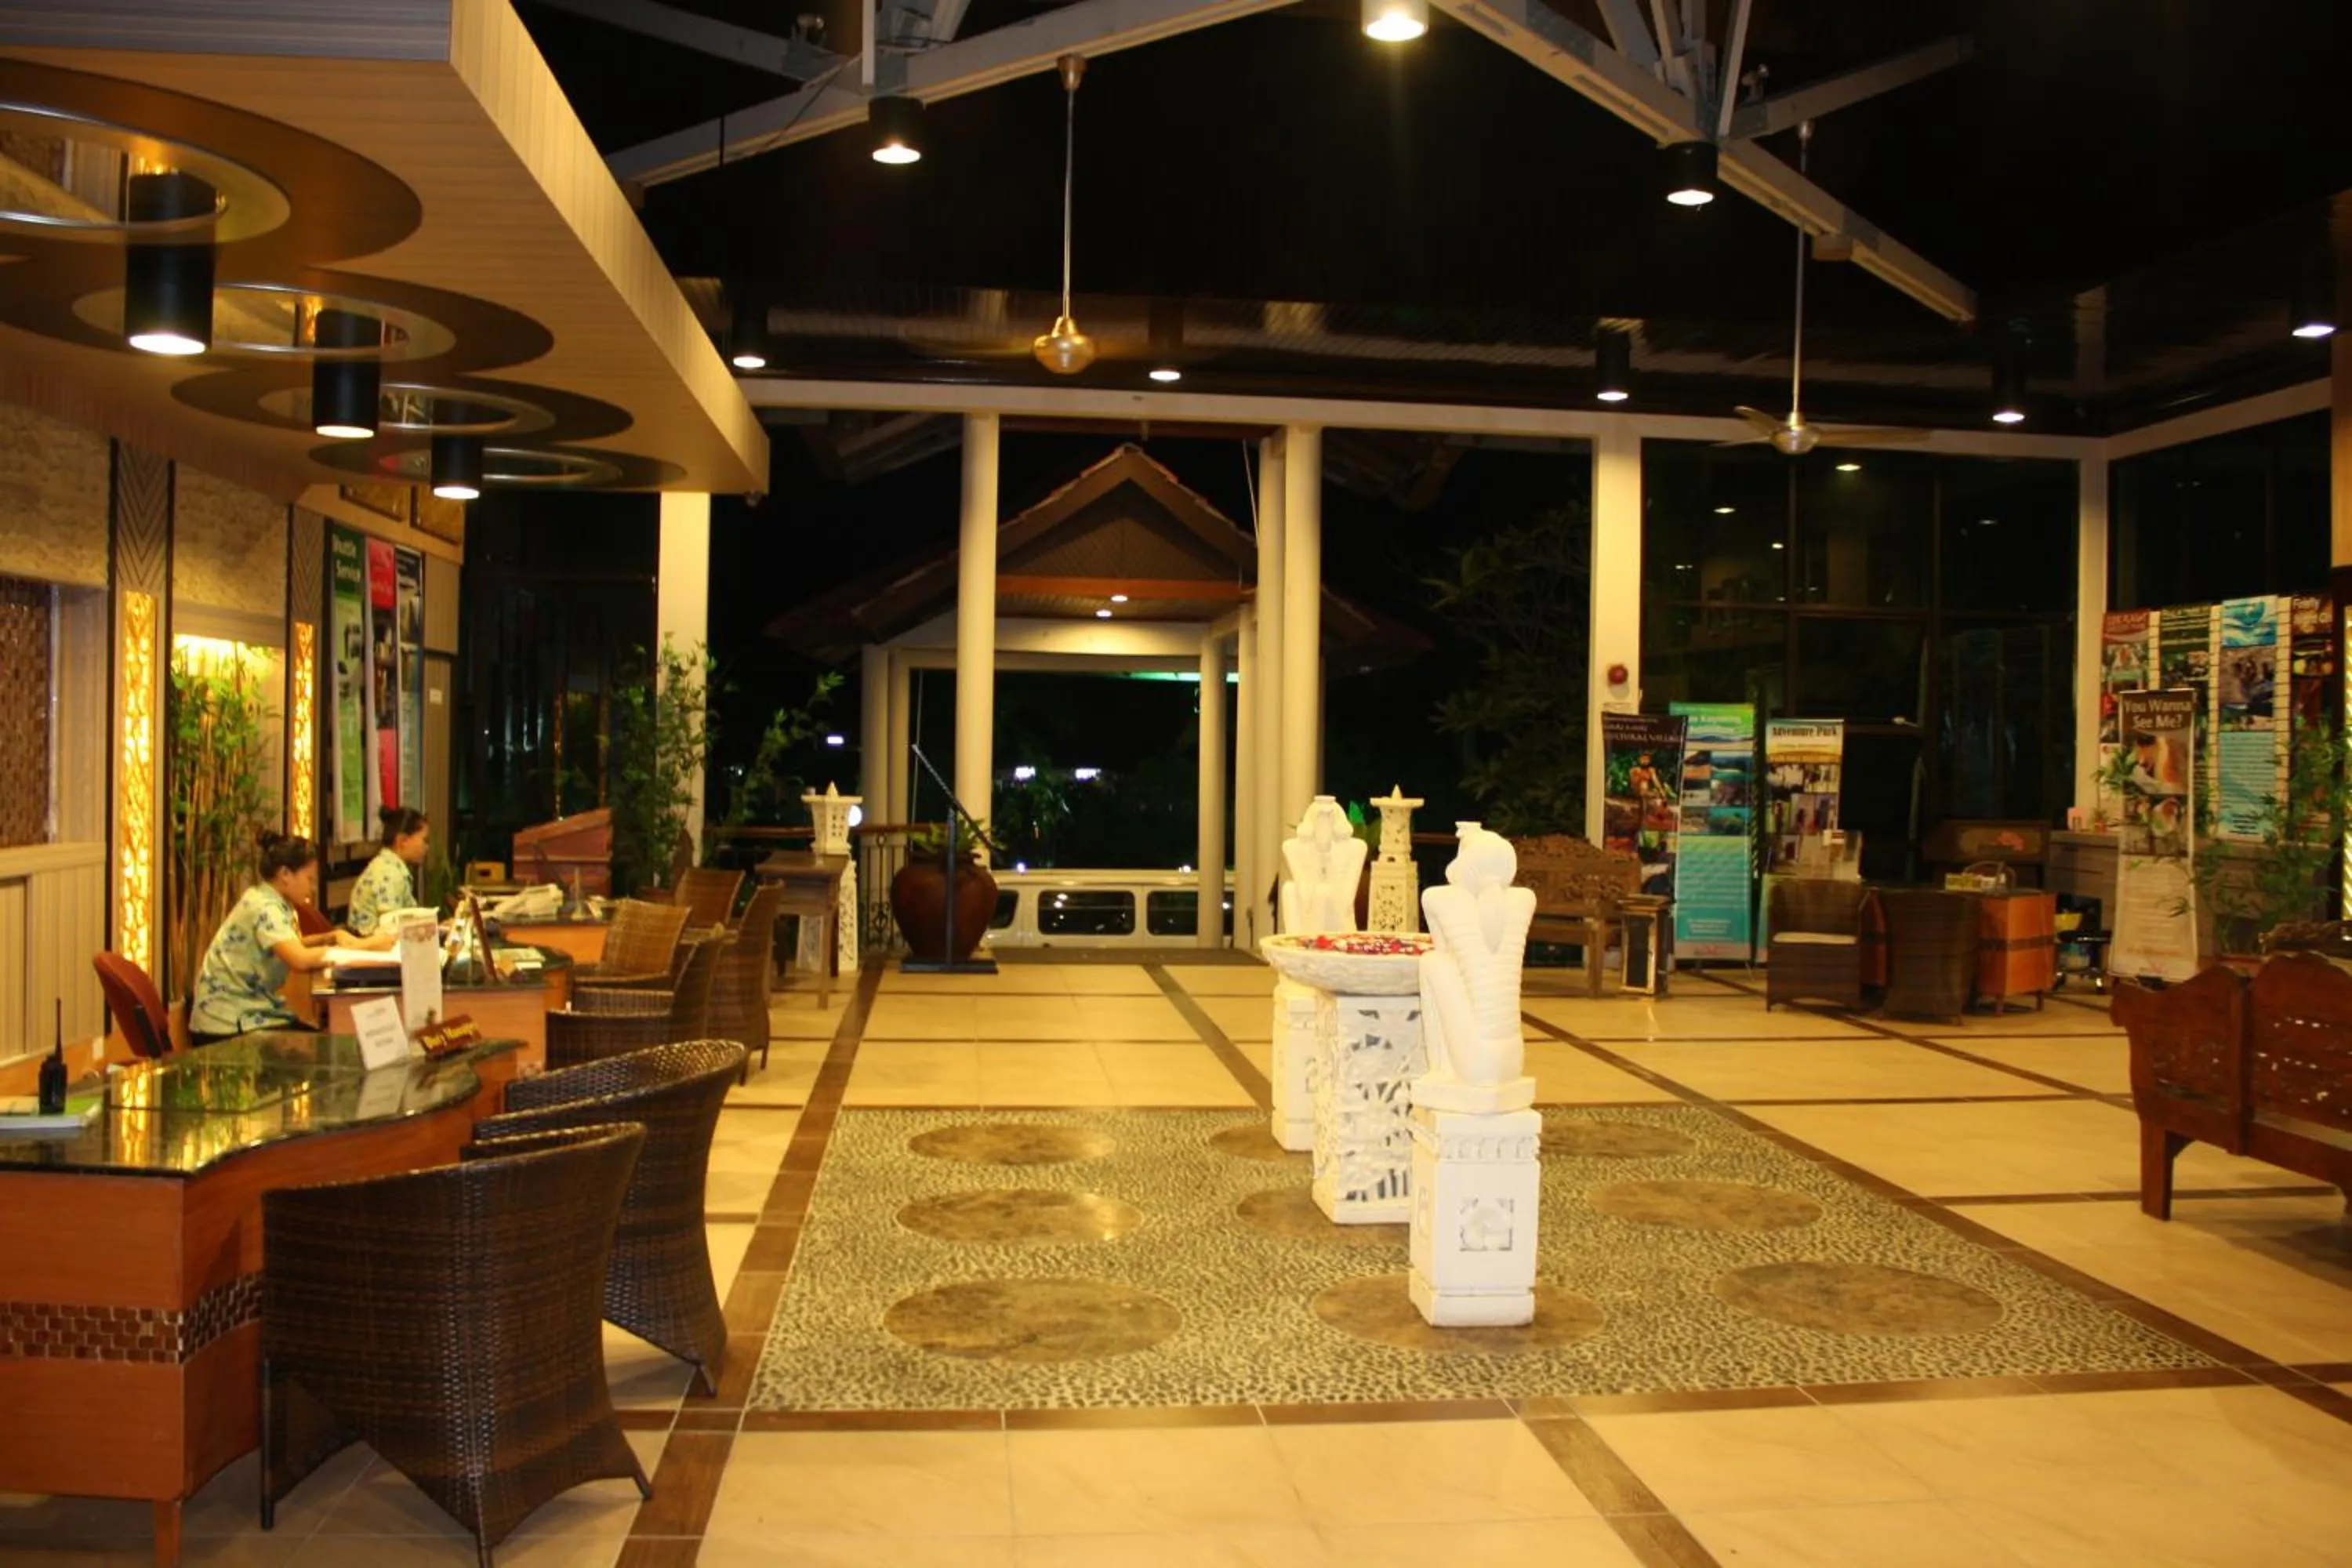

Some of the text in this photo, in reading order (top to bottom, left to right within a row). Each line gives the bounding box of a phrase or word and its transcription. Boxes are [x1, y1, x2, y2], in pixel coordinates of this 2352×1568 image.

[2148, 699, 2192, 712] Wanna
[2132, 713, 2183, 728] See Me?
[1816, 726, 1837, 736] Park
